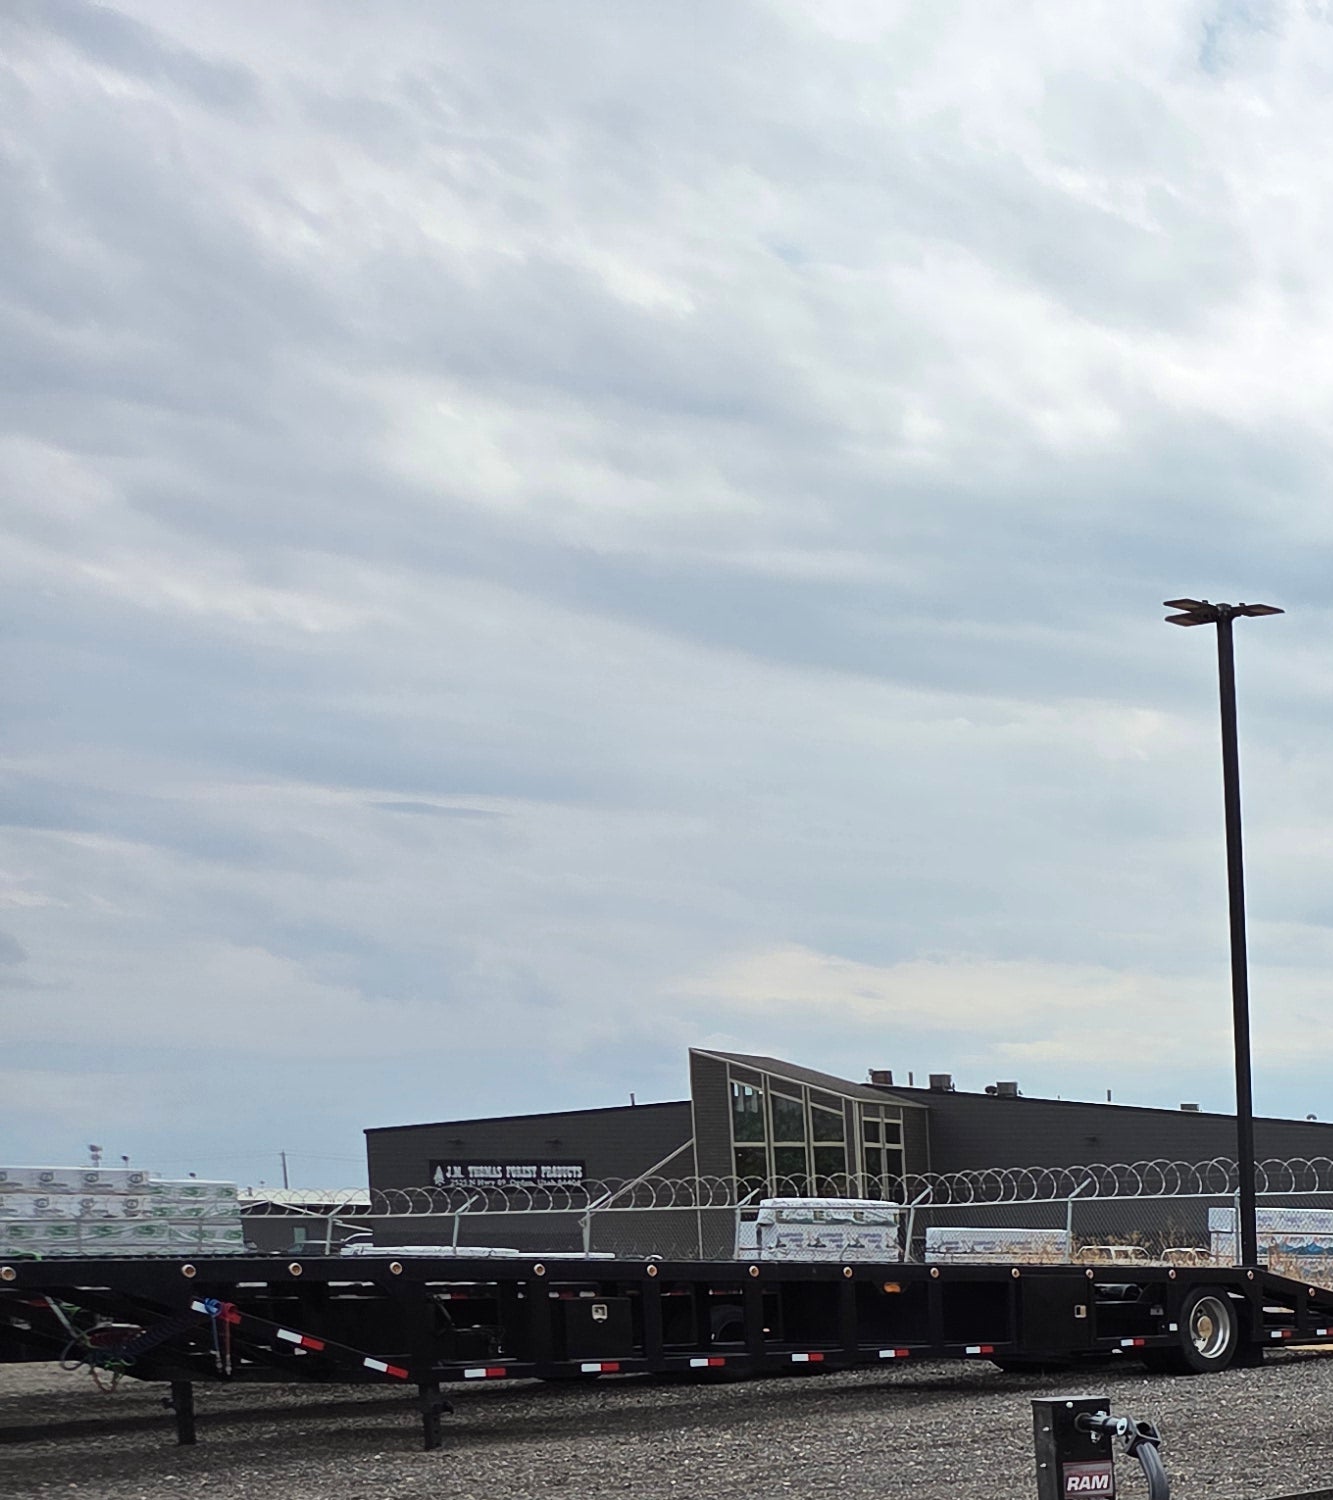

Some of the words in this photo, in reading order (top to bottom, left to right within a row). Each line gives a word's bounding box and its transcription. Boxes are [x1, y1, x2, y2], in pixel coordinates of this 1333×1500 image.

[468, 1165, 502, 1178] THOMAS
[506, 1165, 537, 1178] FOREST
[541, 1165, 582, 1178] PRODUCTS
[1066, 1474, 1109, 1491] RAM
